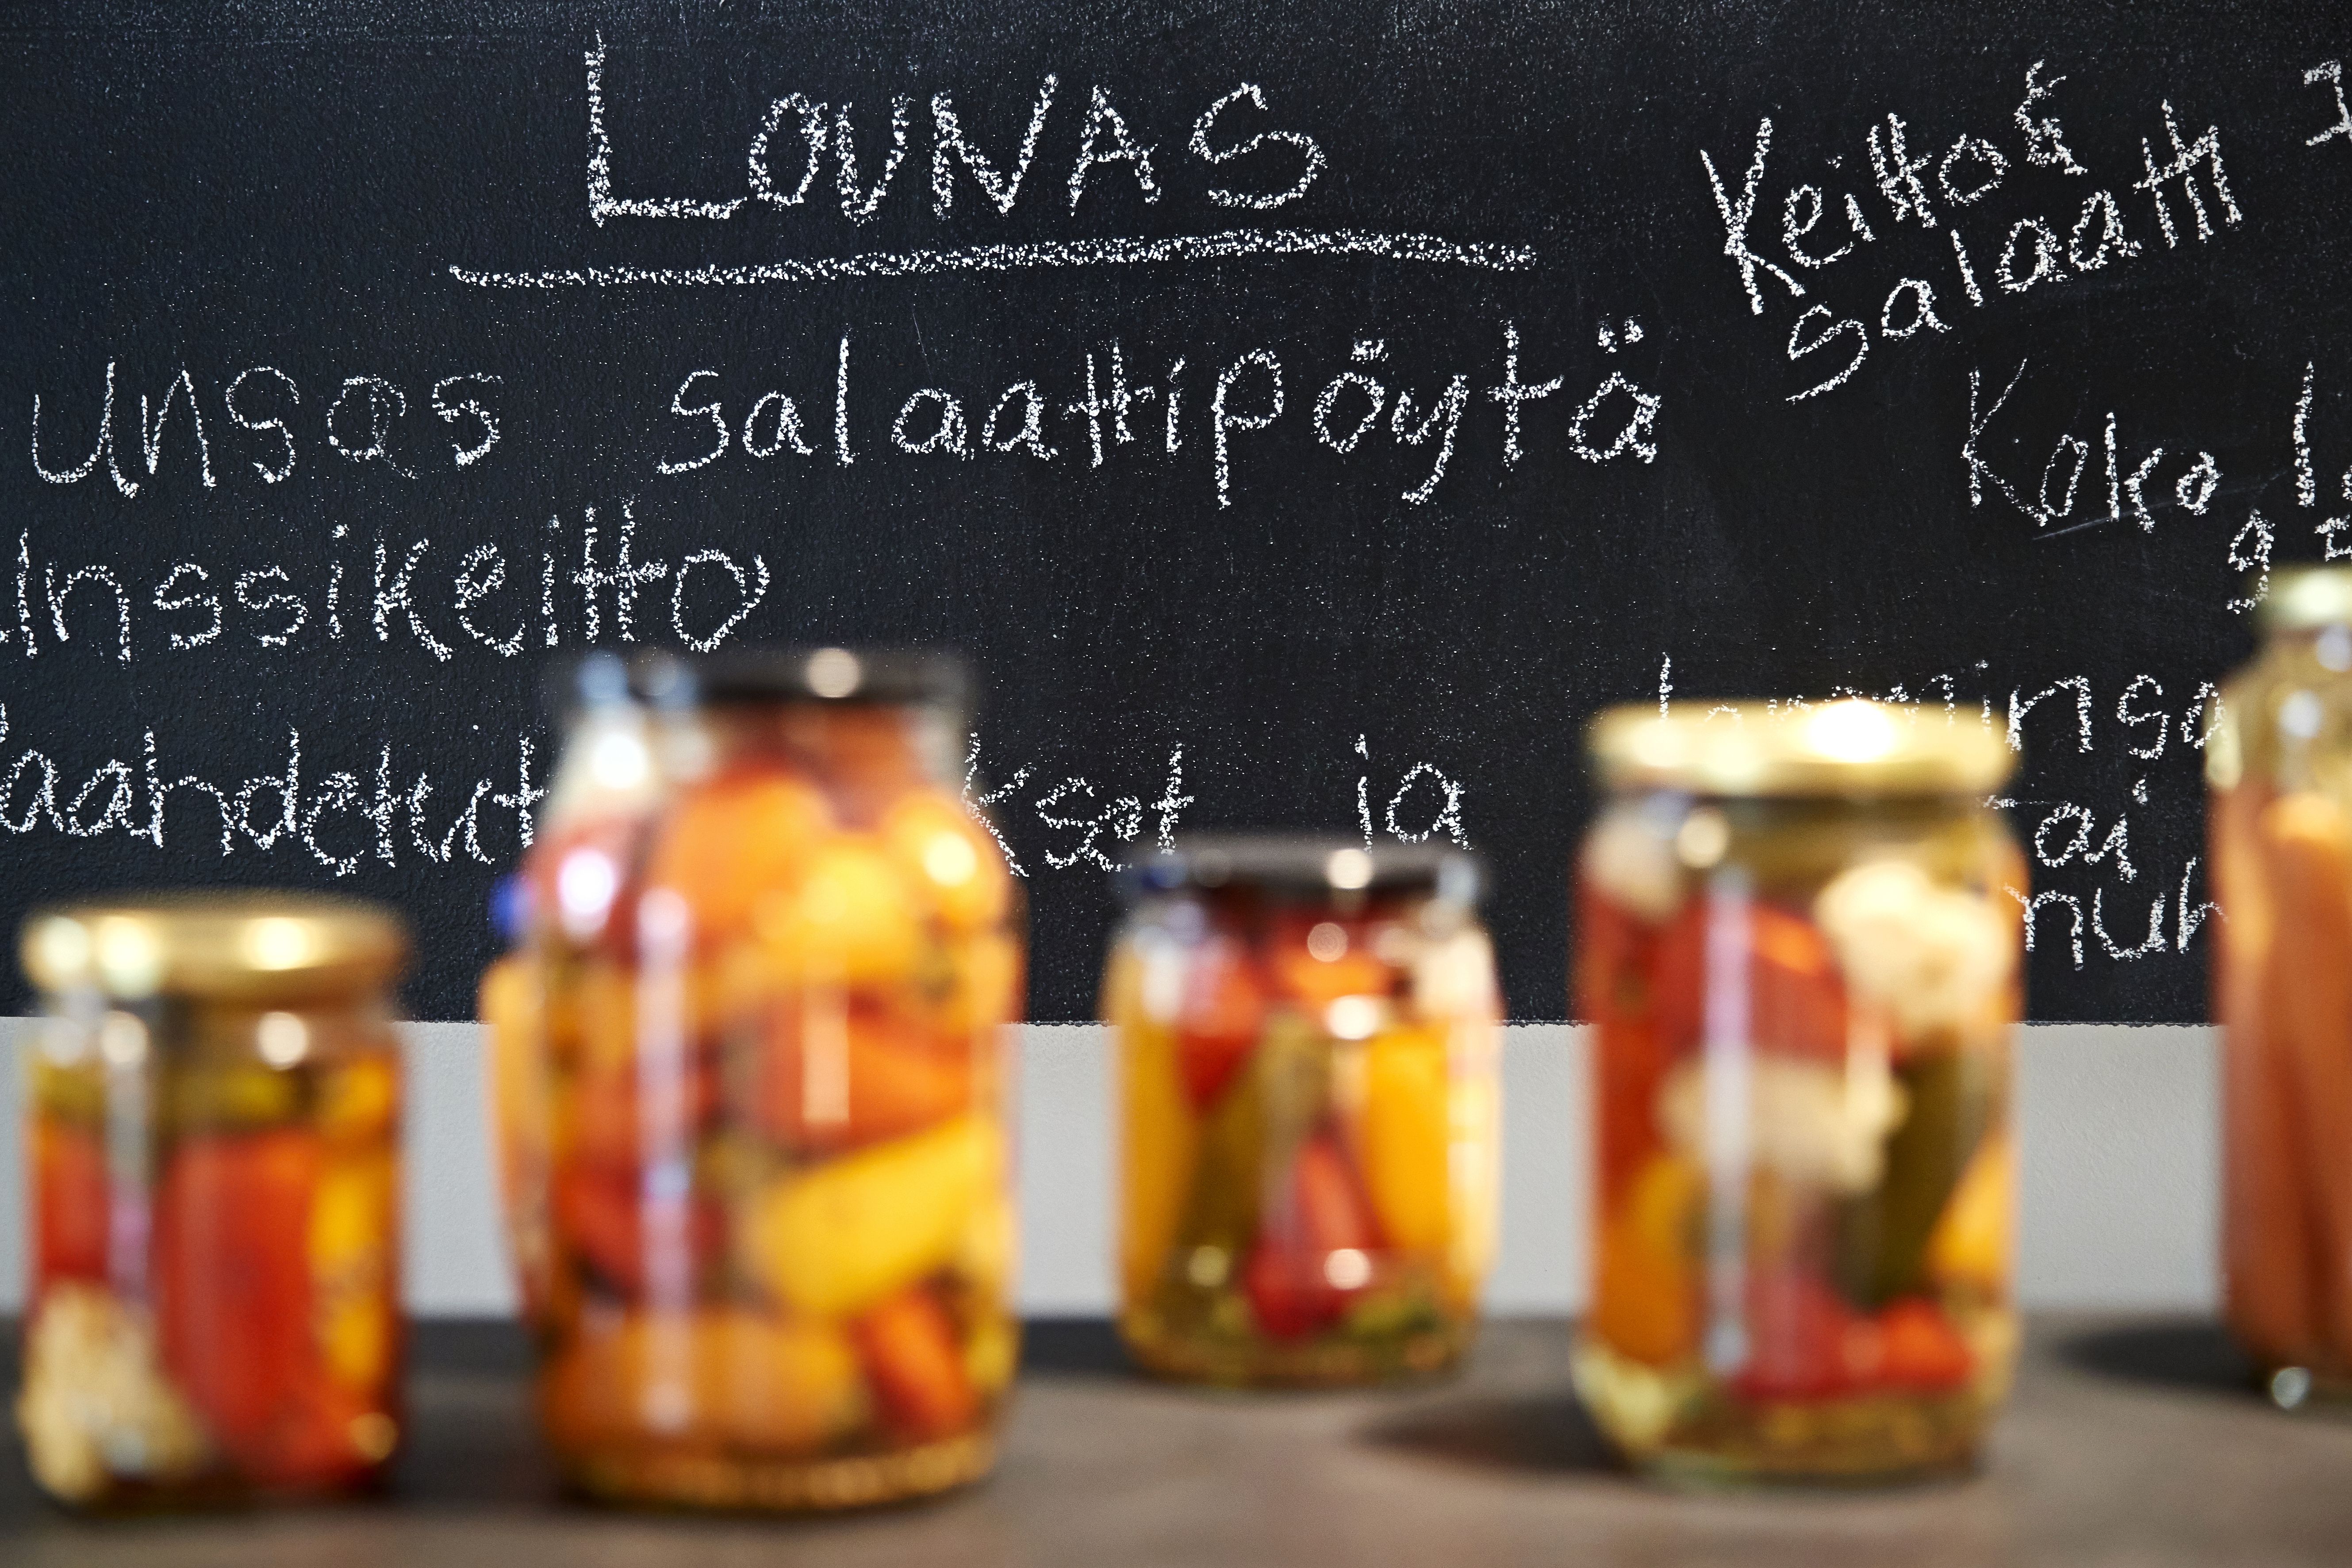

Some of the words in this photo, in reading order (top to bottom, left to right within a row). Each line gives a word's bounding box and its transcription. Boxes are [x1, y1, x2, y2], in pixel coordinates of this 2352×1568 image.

[1700, 113, 2011, 315] Keitto
[0, 491, 770, 668] inssikeitto
[0, 703, 549, 876] aahdetut
